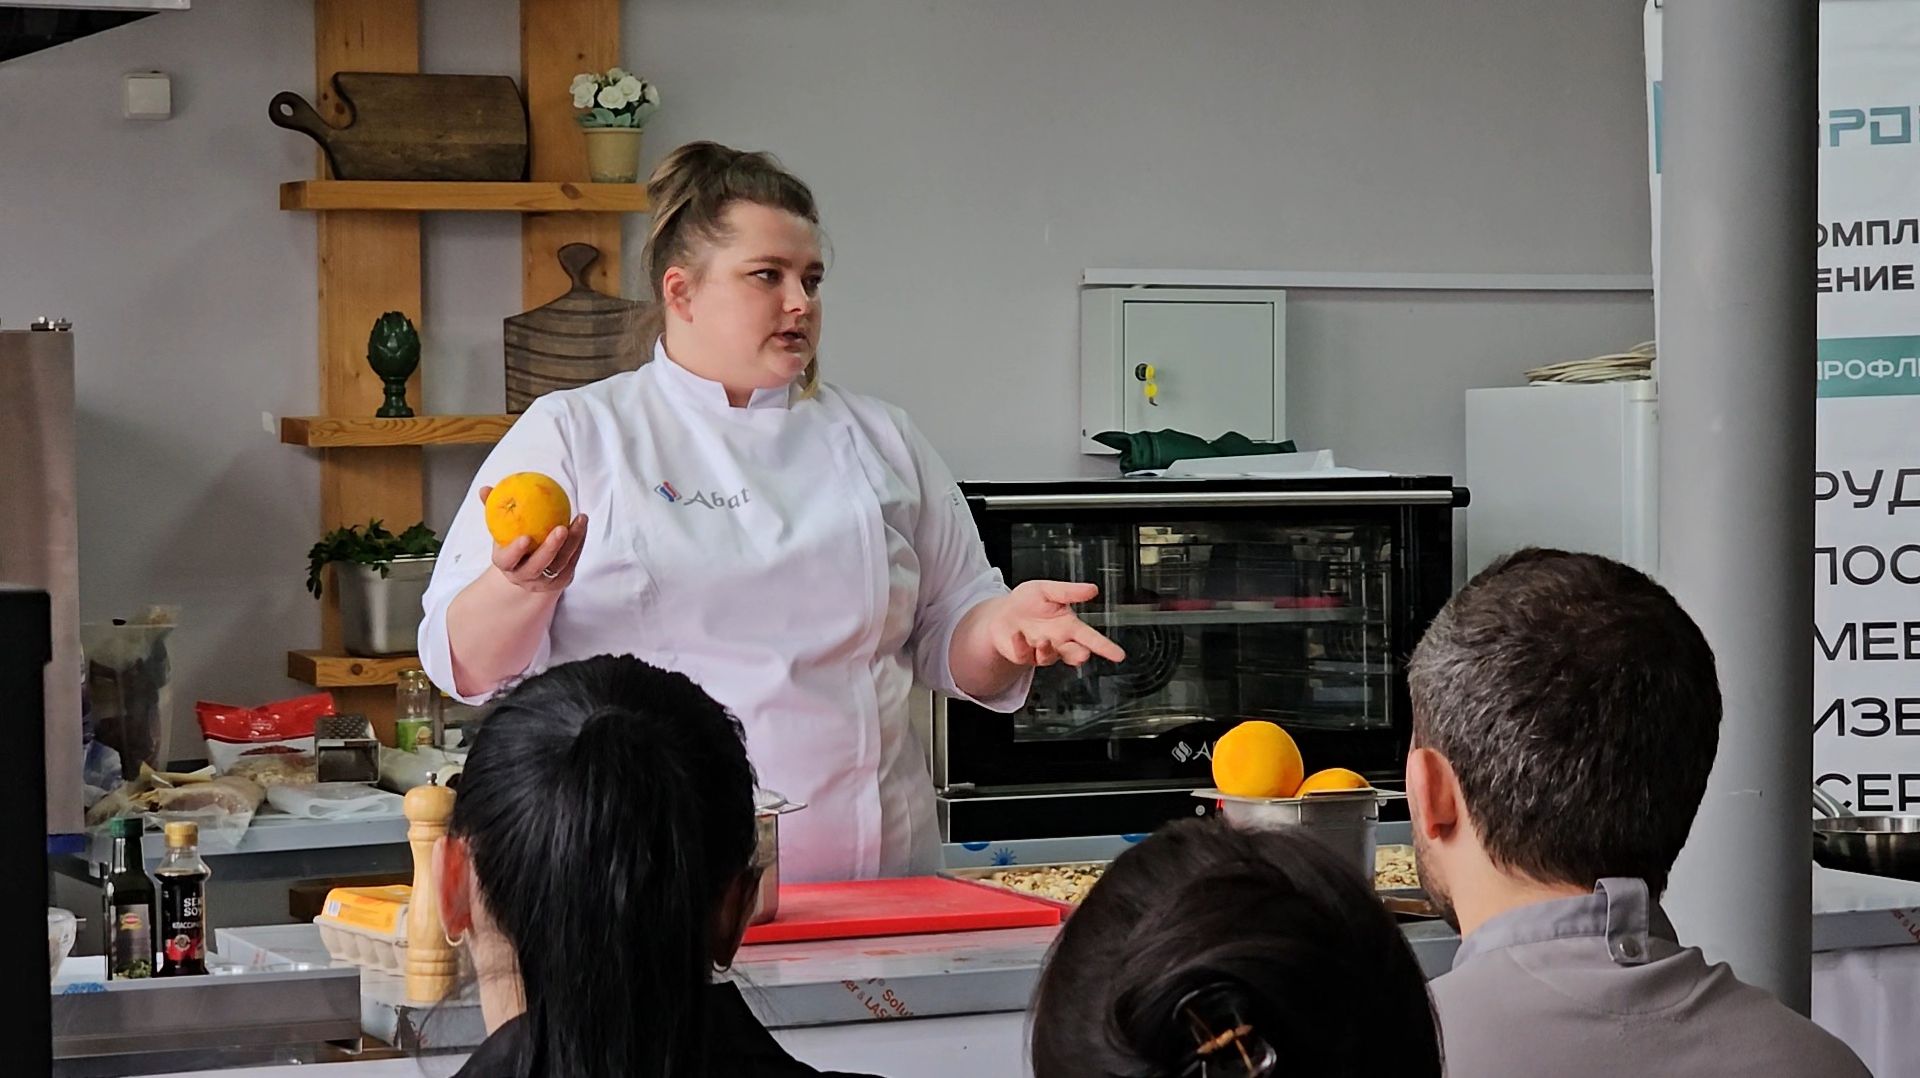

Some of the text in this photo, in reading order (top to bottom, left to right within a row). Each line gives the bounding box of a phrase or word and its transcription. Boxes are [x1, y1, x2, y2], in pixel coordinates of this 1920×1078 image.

[1817, 264, 1914, 293] ЕНИЕ
[1817, 357, 1920, 380] РОФЛ
[683, 488, 751, 510] Abat
[1192, 740, 1216, 762] A
